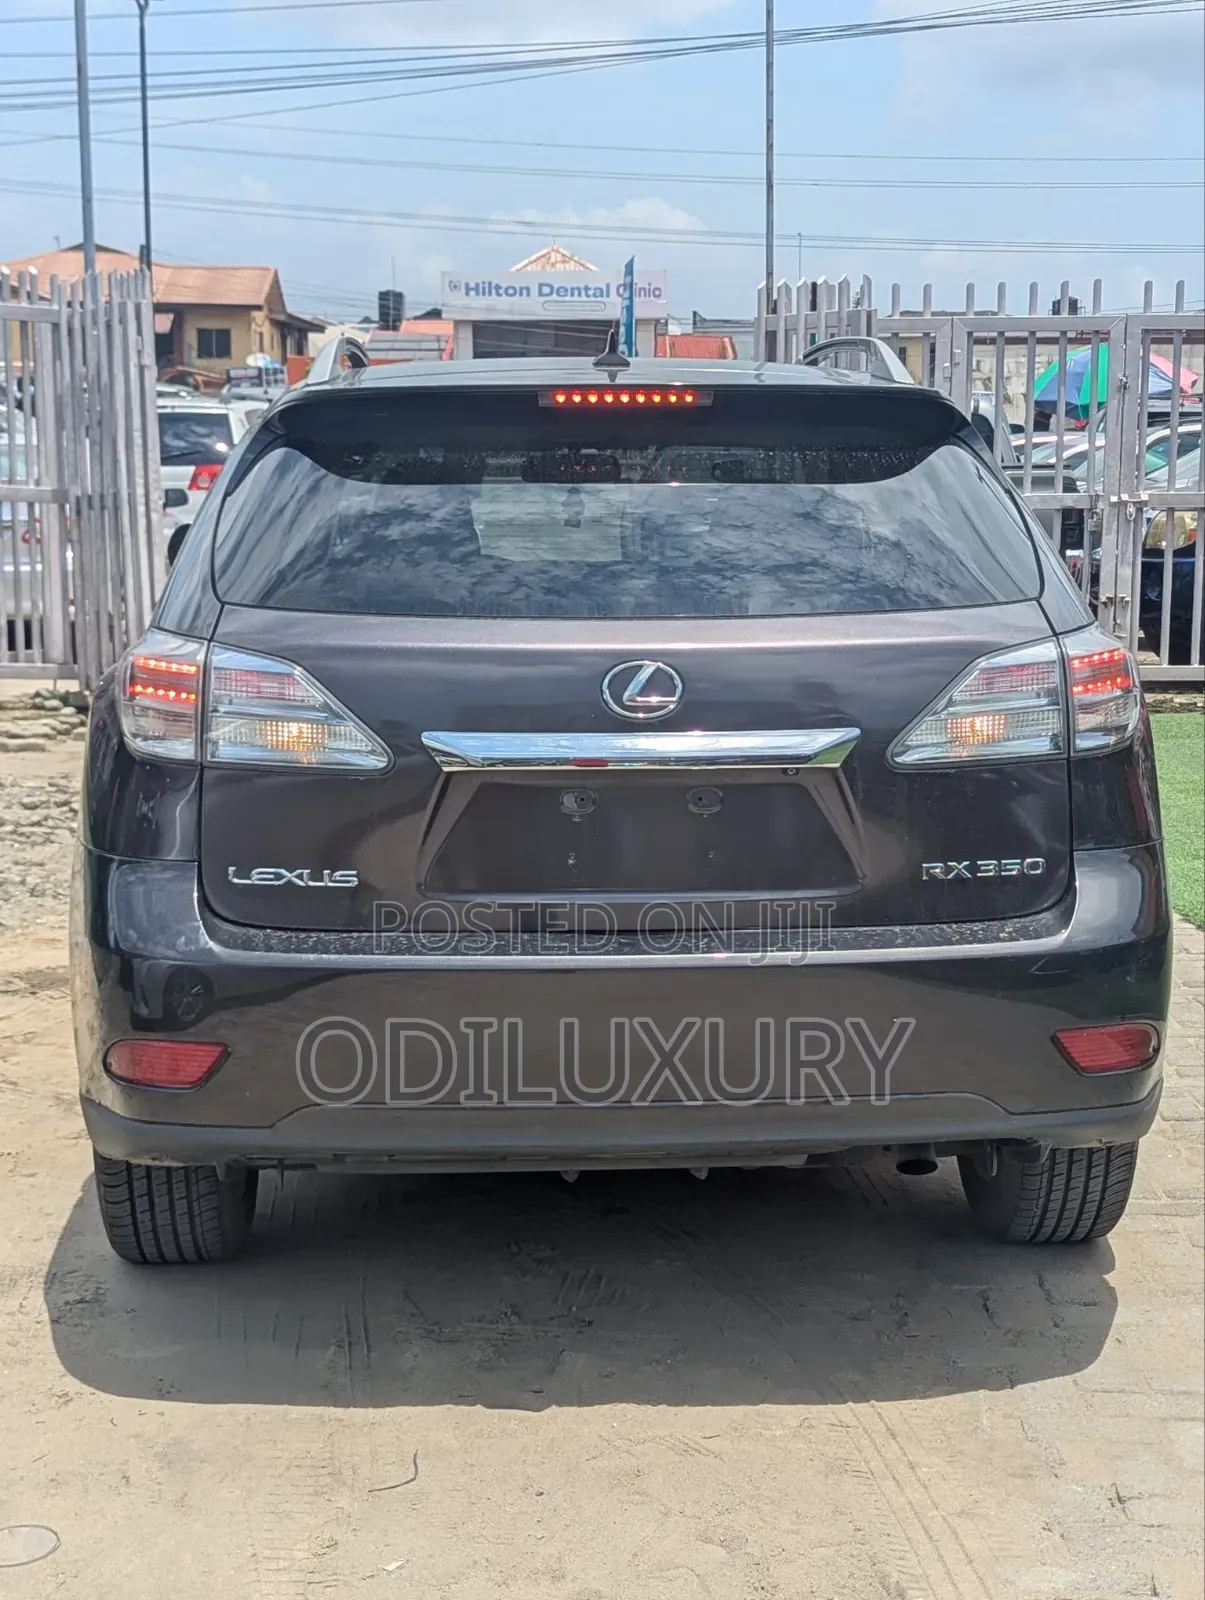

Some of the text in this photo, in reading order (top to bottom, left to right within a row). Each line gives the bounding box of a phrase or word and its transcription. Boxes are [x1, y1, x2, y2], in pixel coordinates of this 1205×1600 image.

[464, 281, 662, 299] Hilton Dental Cinic
[228, 866, 359, 887] LEXUS
[921, 857, 1047, 880] RX 350
